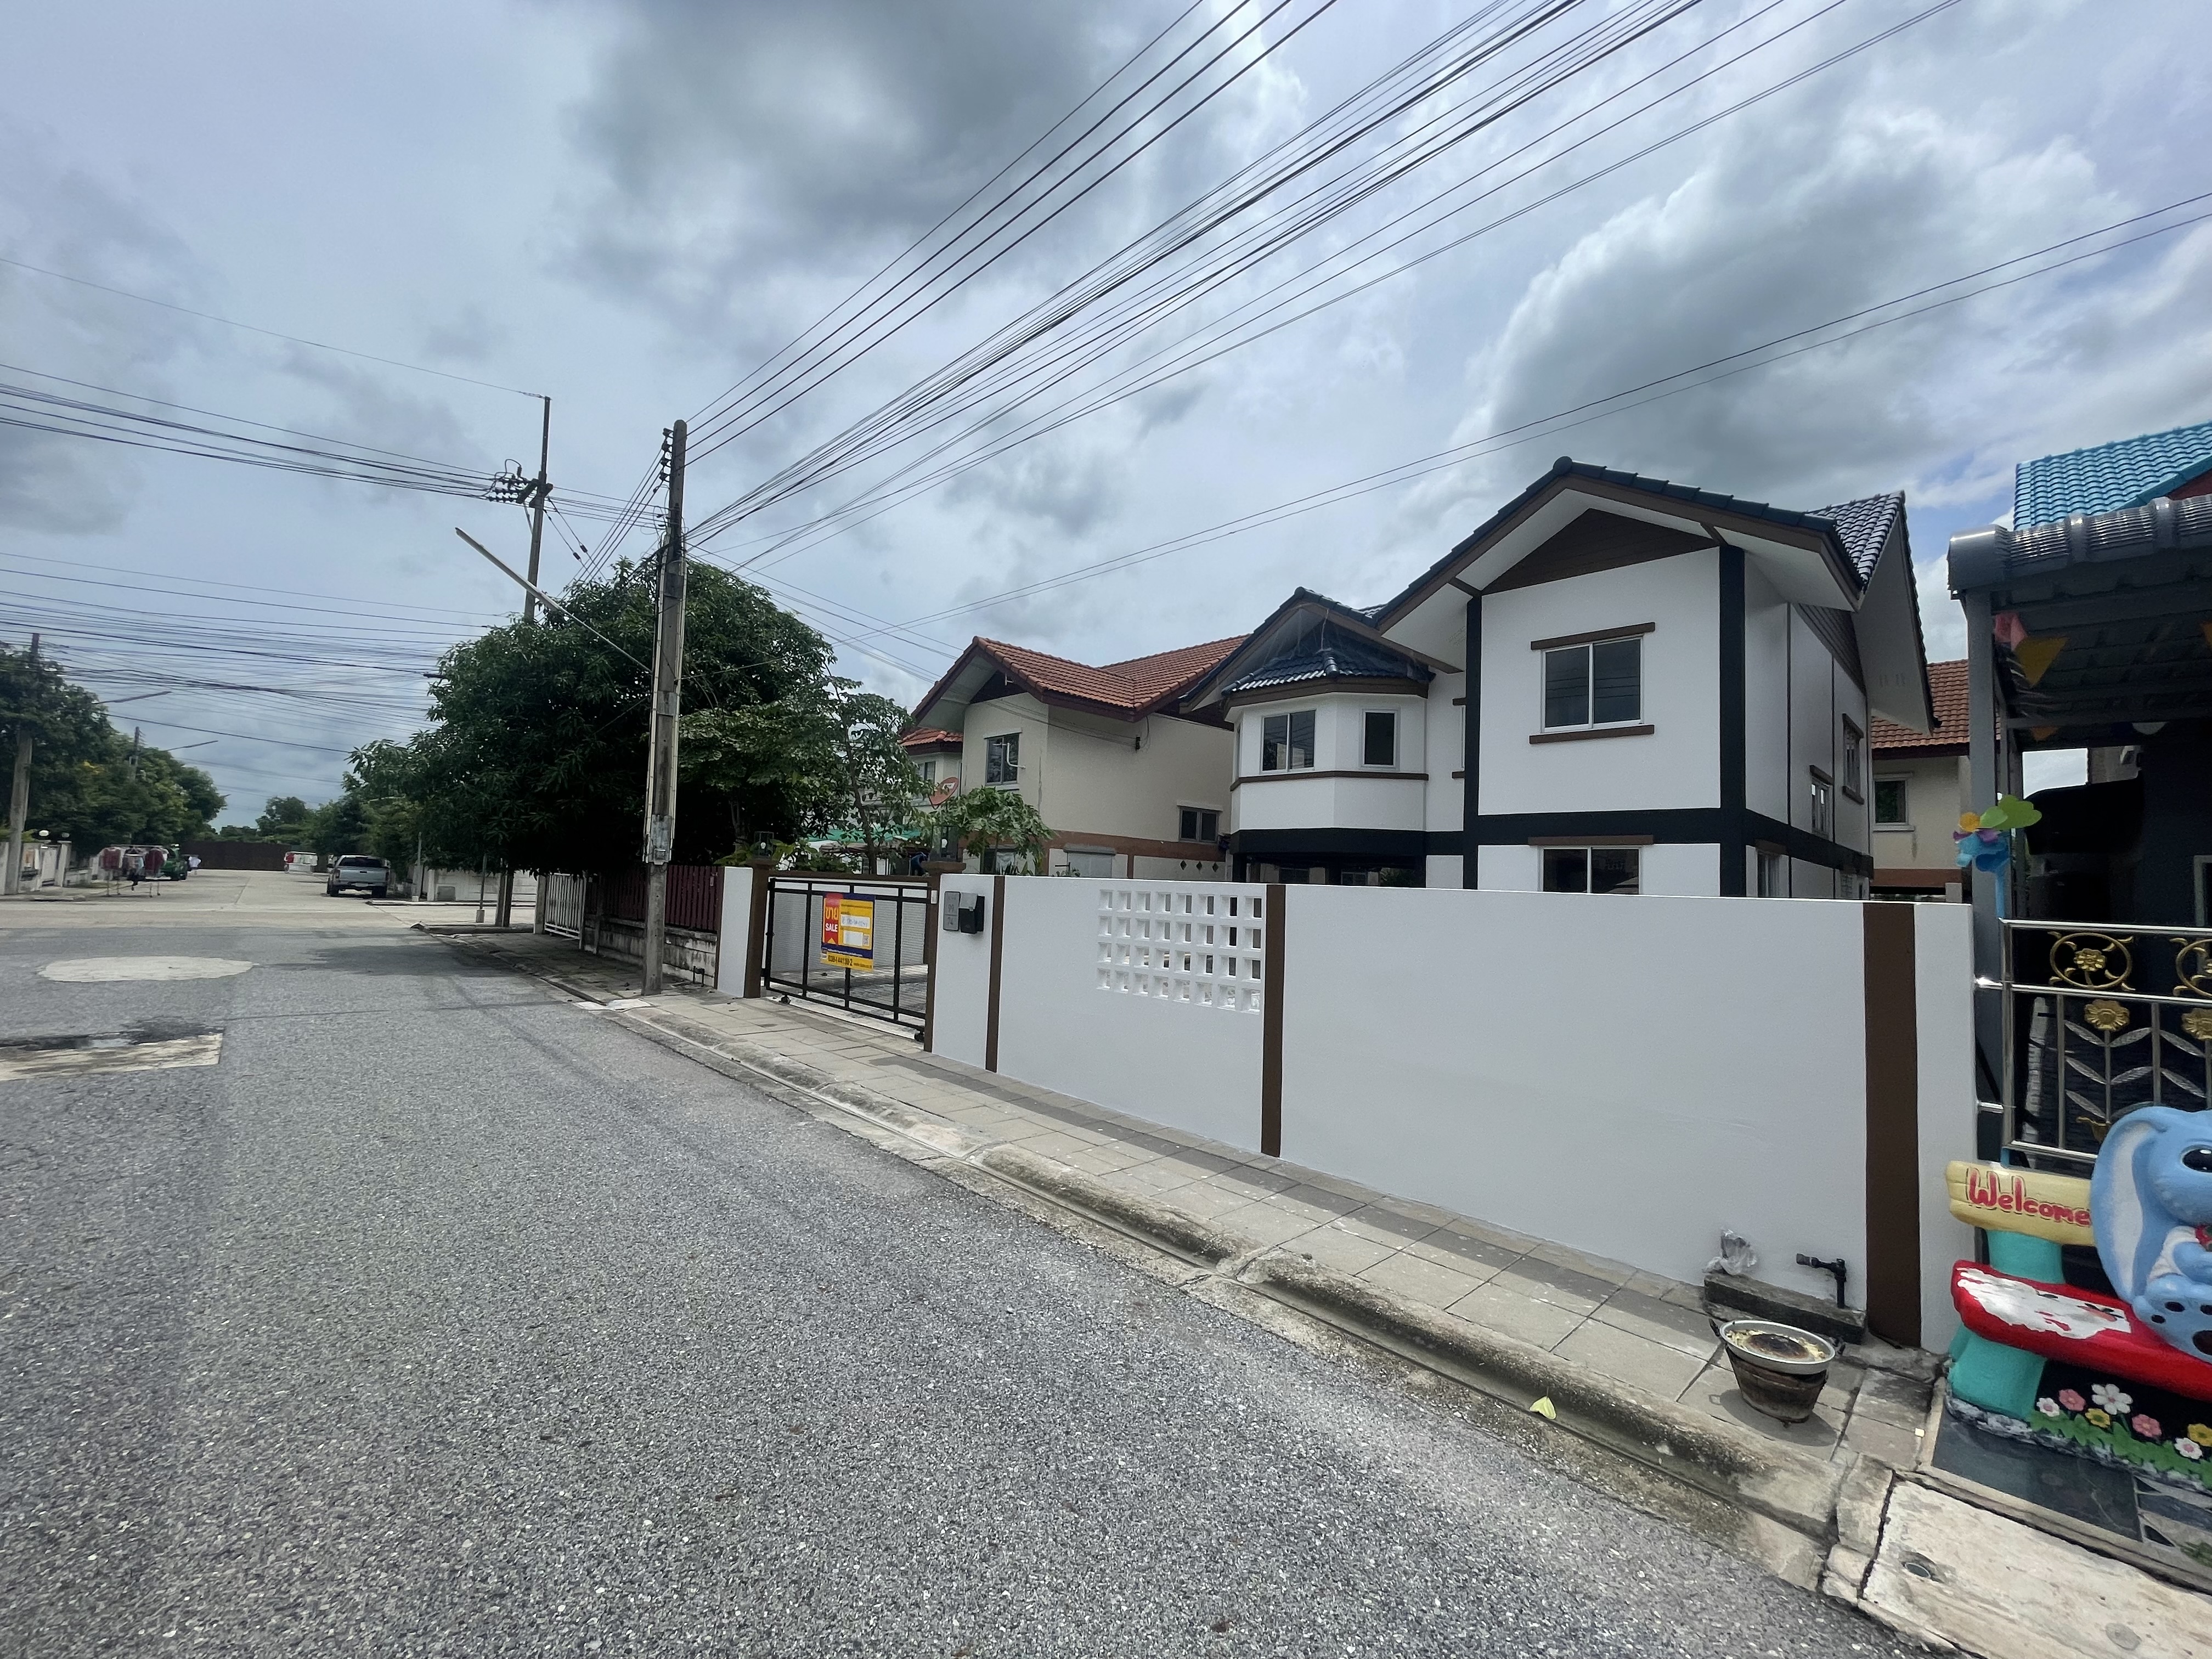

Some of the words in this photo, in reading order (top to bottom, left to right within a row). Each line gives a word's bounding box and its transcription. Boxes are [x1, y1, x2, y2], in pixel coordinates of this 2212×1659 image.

[825, 906, 839, 920] ขาย
[825, 923, 838, 933] SALE
[1966, 1167, 2092, 1227] Welcome
